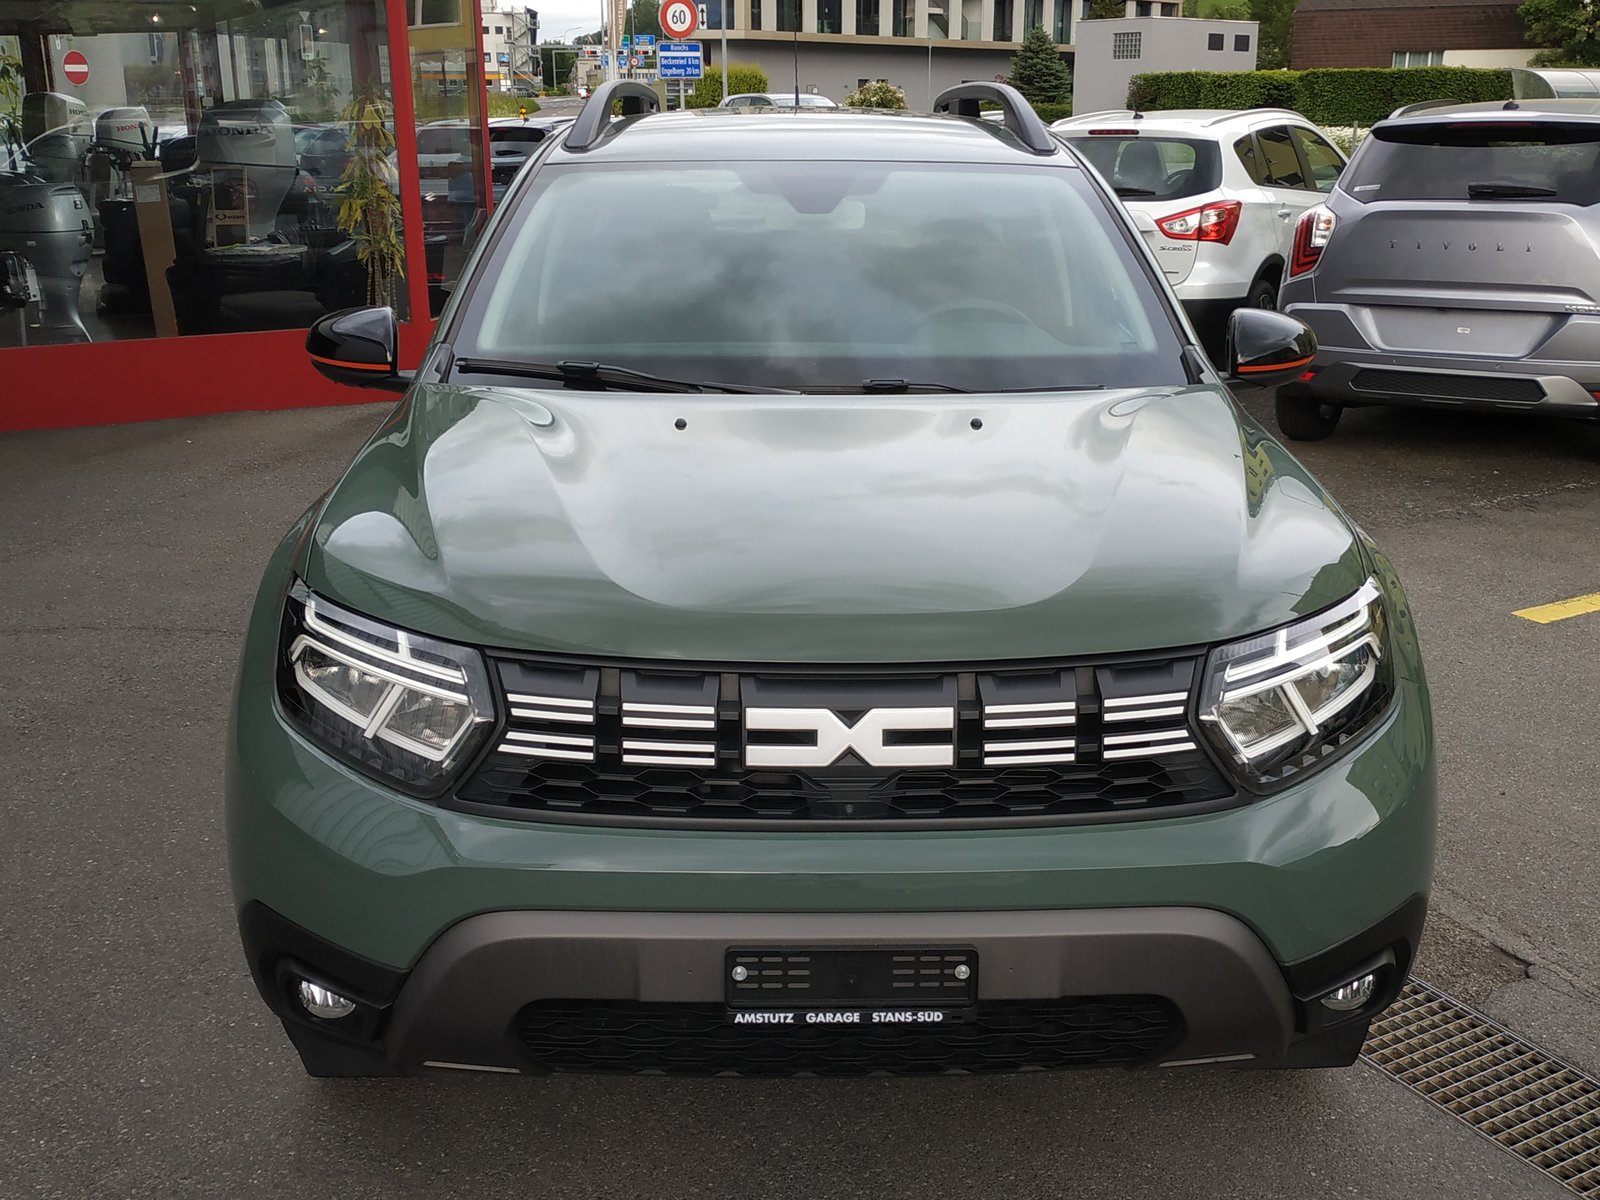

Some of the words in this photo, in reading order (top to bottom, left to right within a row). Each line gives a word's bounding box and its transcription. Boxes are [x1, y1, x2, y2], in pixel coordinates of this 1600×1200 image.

[672, 10, 686, 24] 60
[661, 57, 686, 65] Beckenried
[692, 57, 699, 65] km
[661, 67, 685, 76] Engelberg
[686, 67, 692, 75] 20
[692, 67, 699, 75] km
[69, 108, 90, 117] HON
[1390, 240, 1531, 252] TIVOLI
[734, 1013, 794, 1024] AMSTUTZ
[805, 1012, 860, 1023] GARAGE
[871, 1011, 943, 1022] STANS-SÜD
